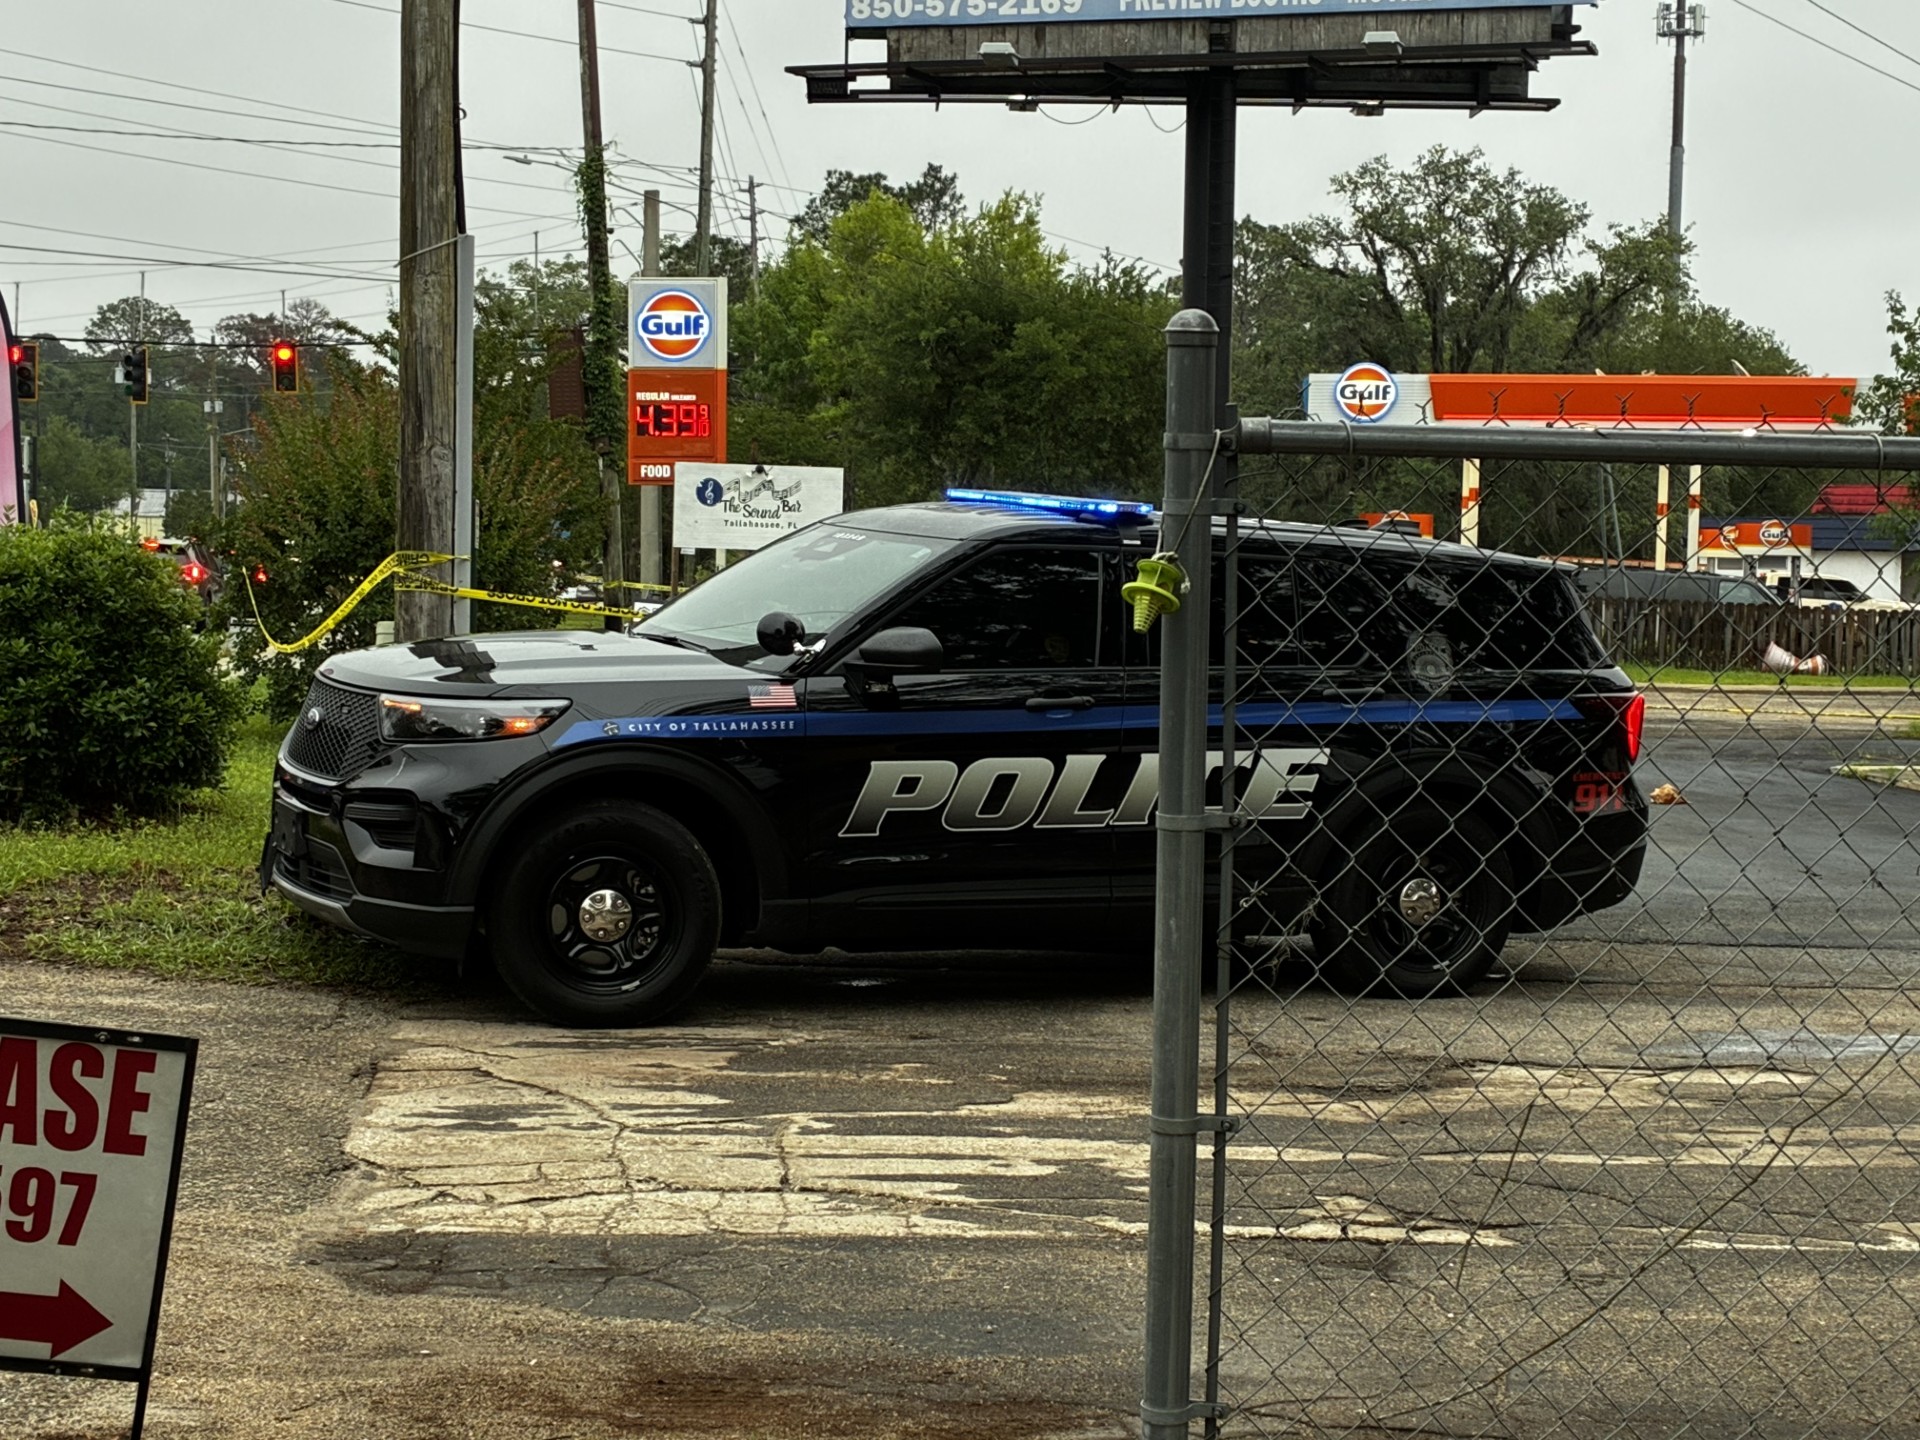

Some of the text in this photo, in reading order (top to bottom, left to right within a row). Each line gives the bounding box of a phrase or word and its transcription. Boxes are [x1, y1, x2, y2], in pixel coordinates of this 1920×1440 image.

[641, 314, 704, 335] Gulf
[1340, 384, 1391, 401] Gulf
[641, 465, 671, 477] FOOD
[719, 496, 802, 519] The Sound Bar
[628, 720, 795, 732] CITY OF TALLAHASSEE
[0, 1164, 98, 1246] 97
